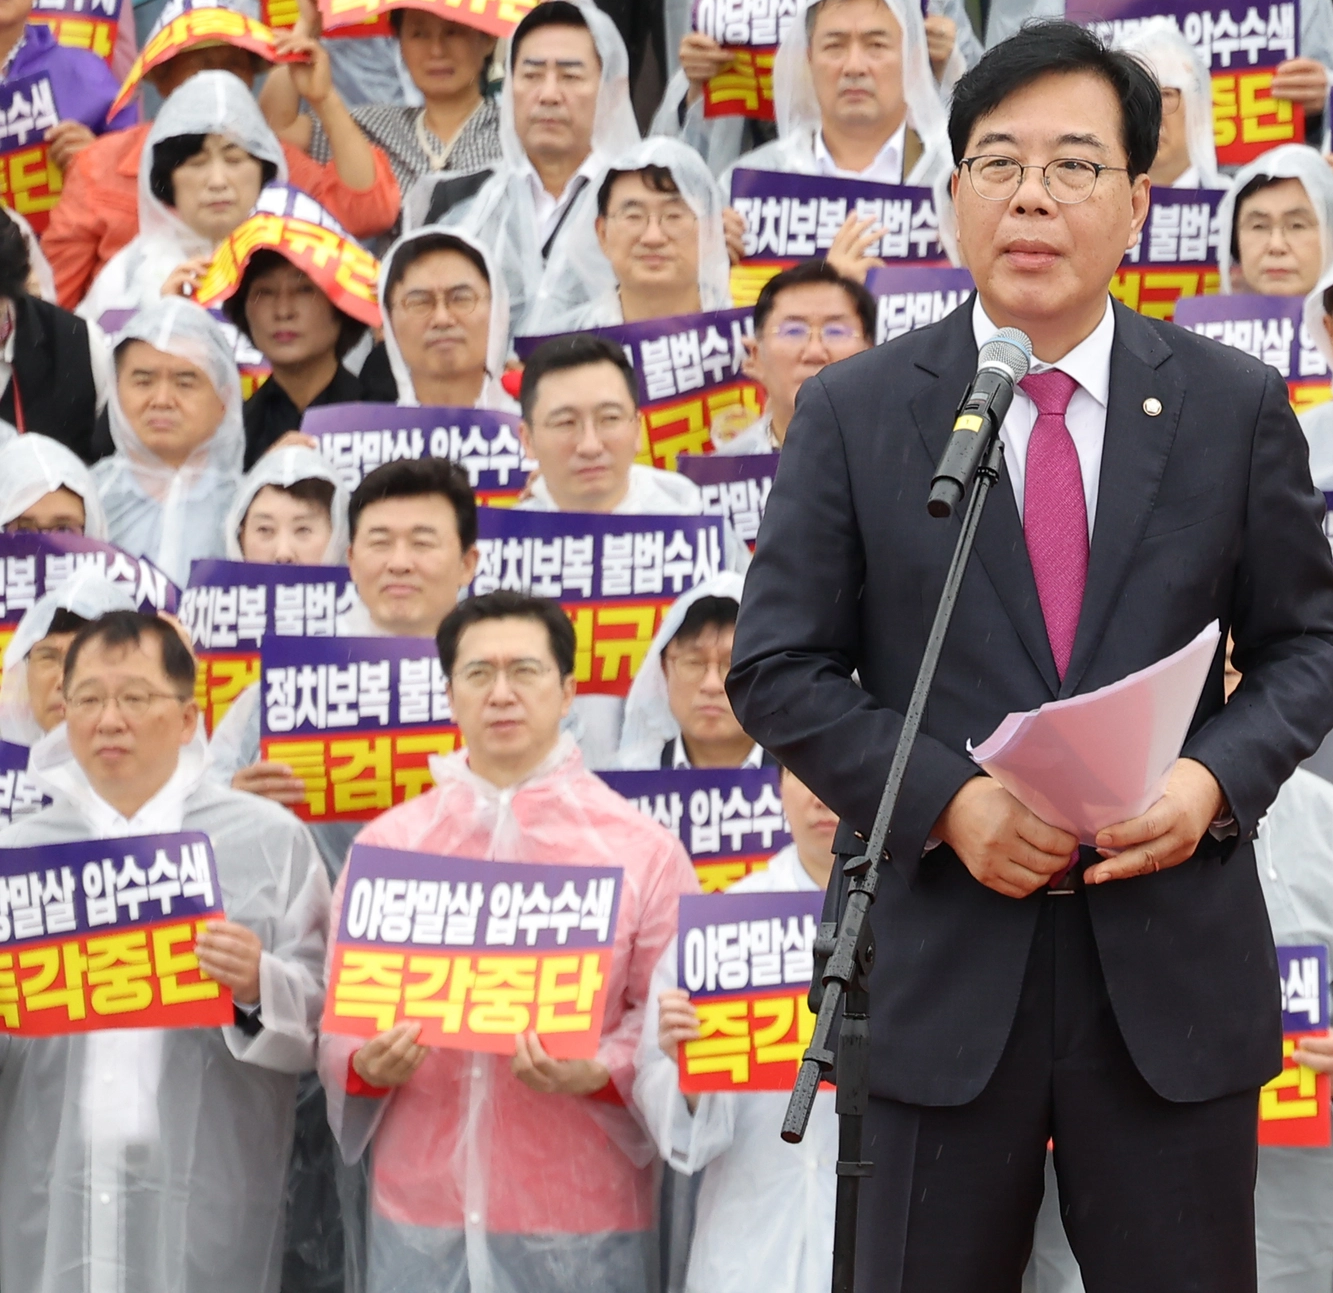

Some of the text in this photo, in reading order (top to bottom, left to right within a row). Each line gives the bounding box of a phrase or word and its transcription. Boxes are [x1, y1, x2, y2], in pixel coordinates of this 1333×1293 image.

[742, 202, 851, 260] 정치보복
[642, 324, 758, 400] 불법수사
[431, 425, 534, 488] 압수수
[474, 525, 723, 596] 정치보복 불법수사
[266, 660, 392, 734] 정치보복
[268, 735, 462, 819] 특검규
[690, 781, 790, 855] 압수수
[82, 841, 214, 920] 압수수색
[347, 876, 615, 945] 야당말살 압수수색
[685, 914, 814, 991] 야당말살
[334, 951, 603, 1035] 즉각중단
[684, 994, 814, 1083] 즉각
